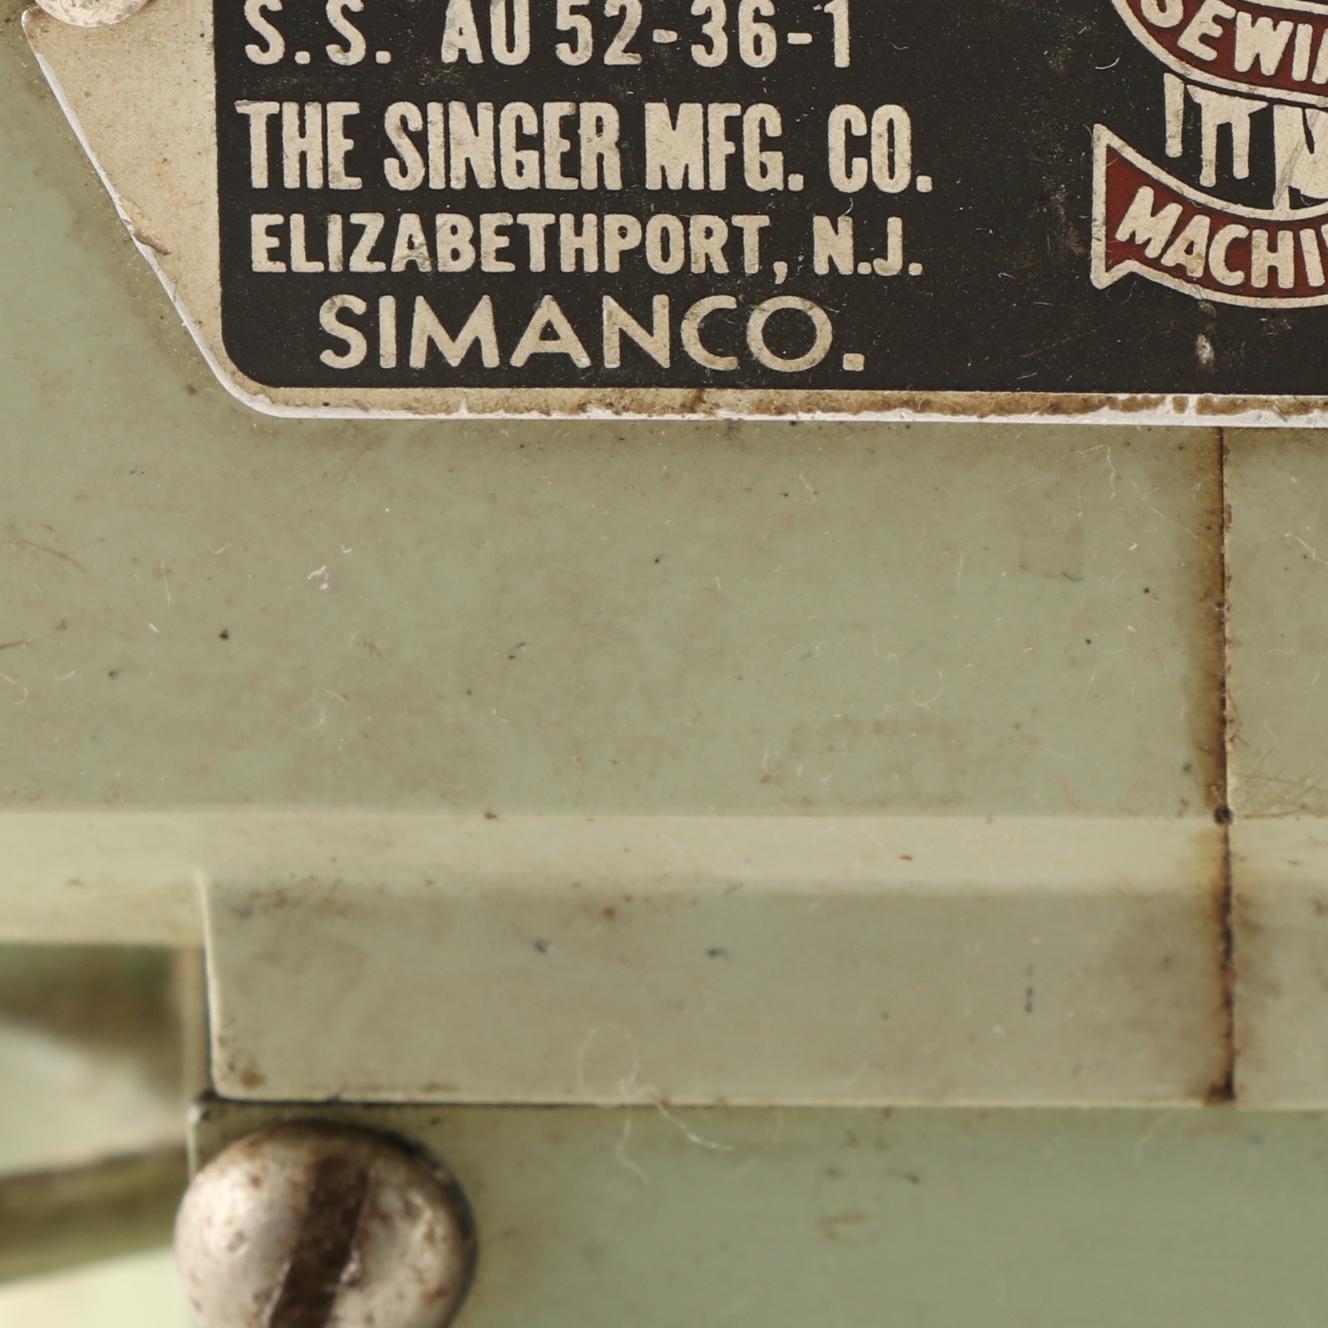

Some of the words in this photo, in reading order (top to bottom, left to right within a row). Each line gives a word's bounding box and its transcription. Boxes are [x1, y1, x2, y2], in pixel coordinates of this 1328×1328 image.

[234, 99, 363, 191] THE
[383, 100, 624, 192] SINGER
[644, 102, 805, 193] MFG.
[827, 103, 934, 194] CO.
[250, 213, 790, 286] ELIZABETHPORT,
[812, 214, 924, 277] N.J.
[318, 293, 866, 373] SIMANCO.
